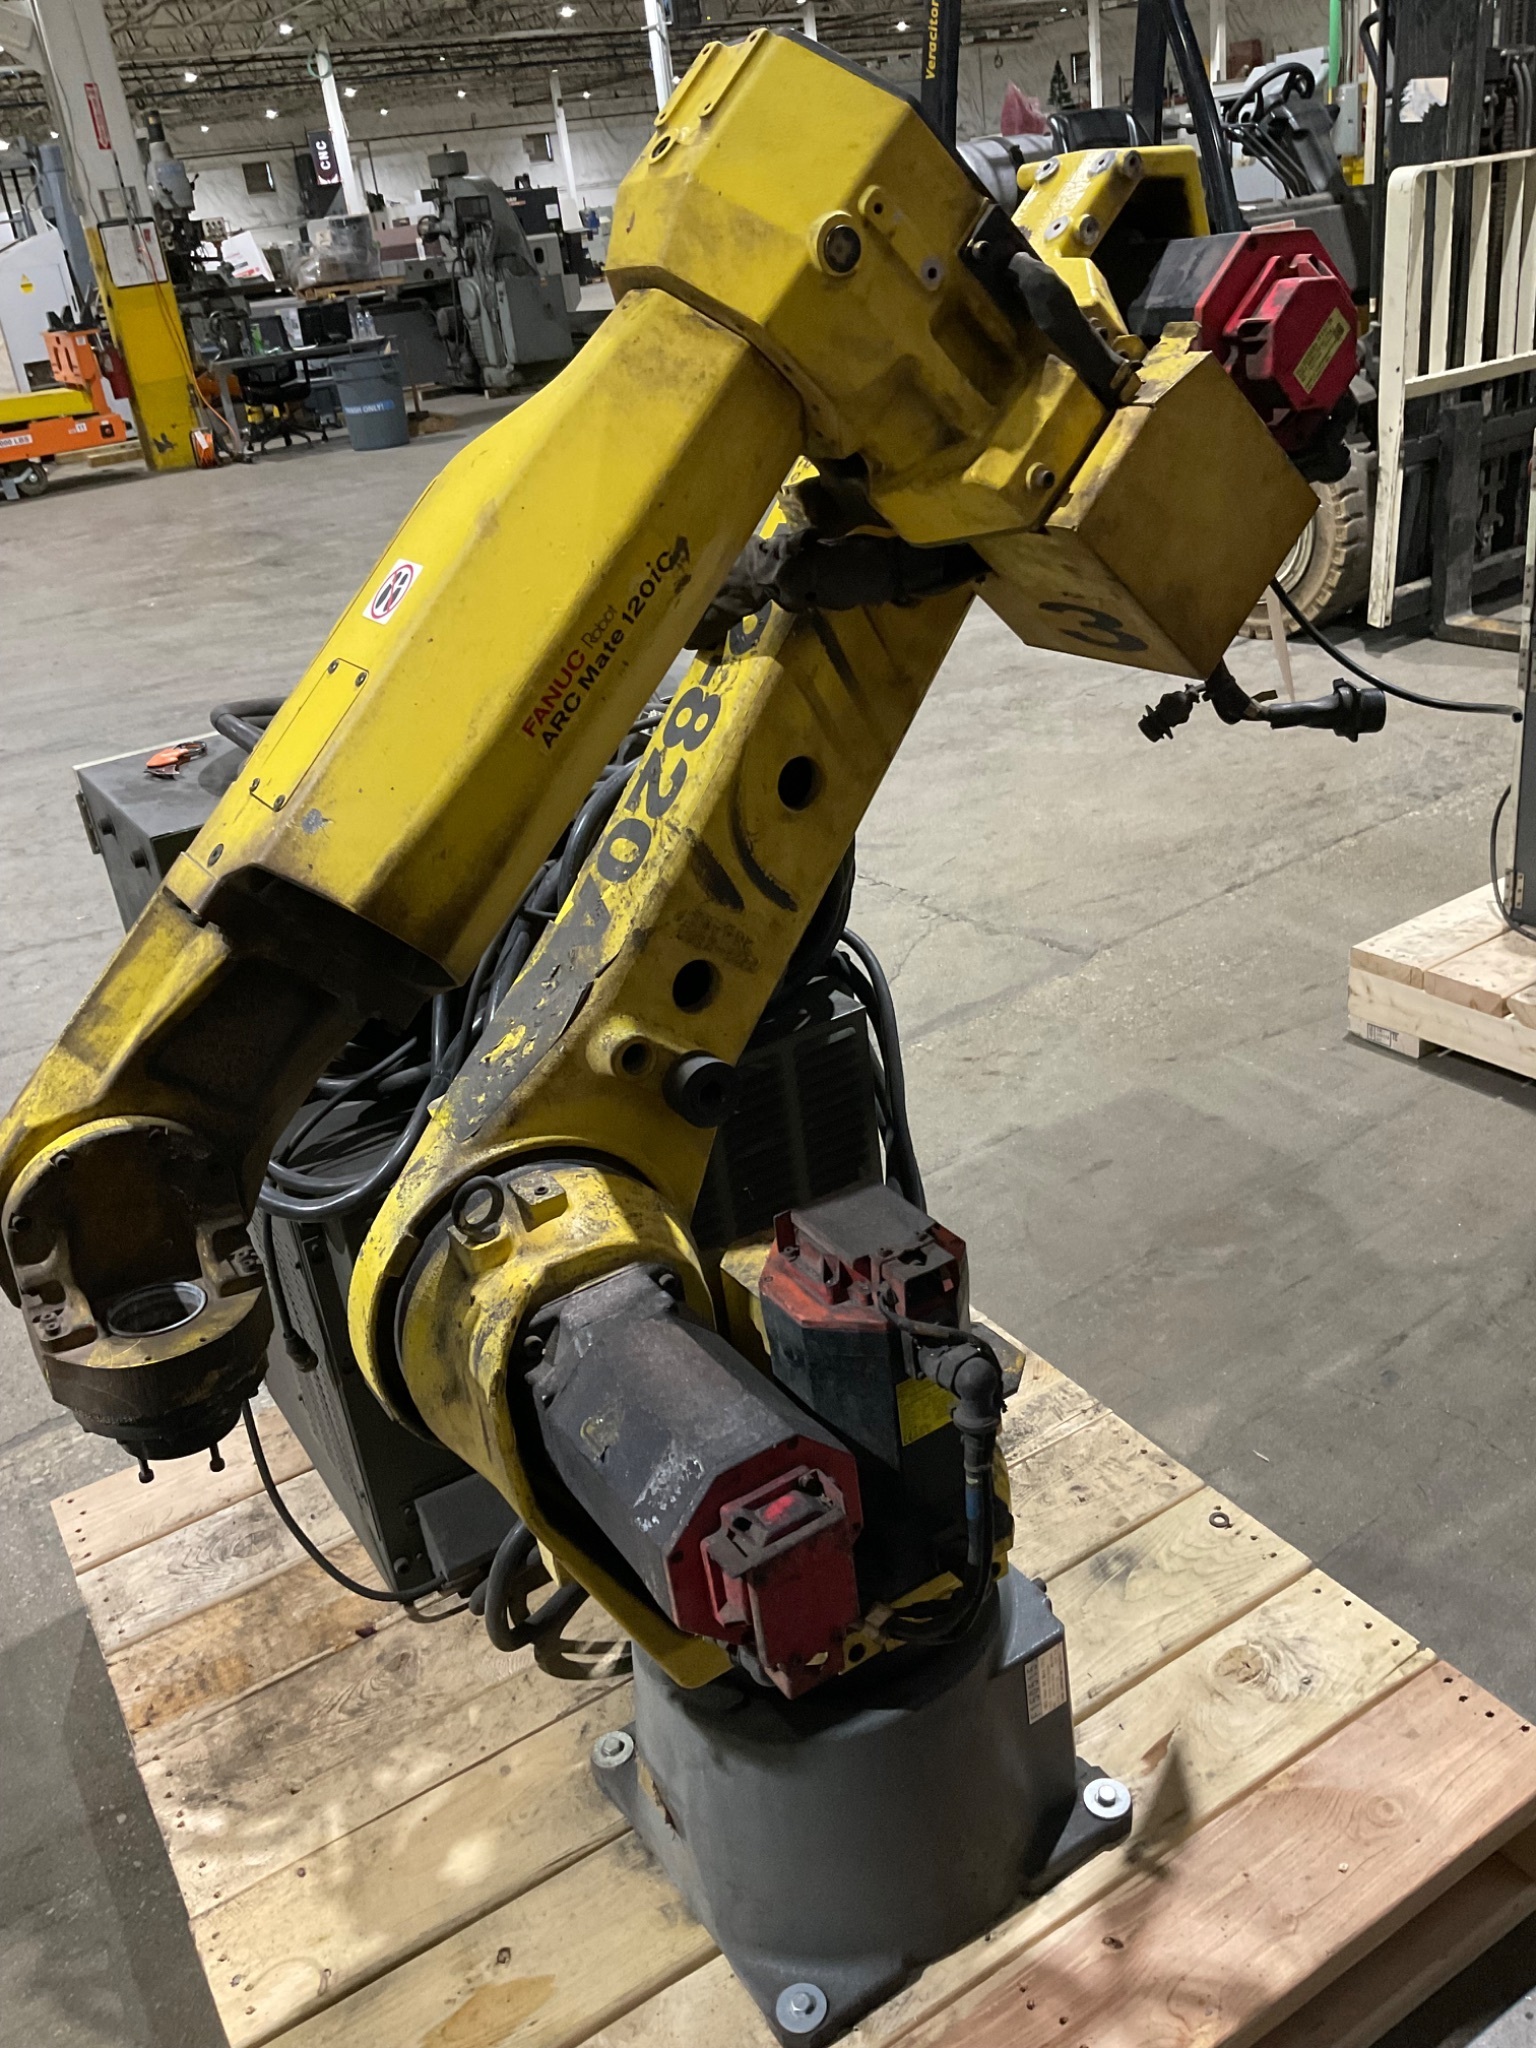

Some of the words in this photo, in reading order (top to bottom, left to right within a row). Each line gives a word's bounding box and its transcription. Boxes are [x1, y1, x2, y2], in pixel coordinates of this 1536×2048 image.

[925, 0, 940, 79] Veracitor
[315, 140, 331, 170] CNC
[540, 692, 581, 749] ARC
[578, 628, 625, 692] Mate
[621, 549, 679, 625] 120iC
[1038, 602, 1149, 652] 3
[521, 649, 585, 738] FANUC
[581, 604, 618, 650] Robot
